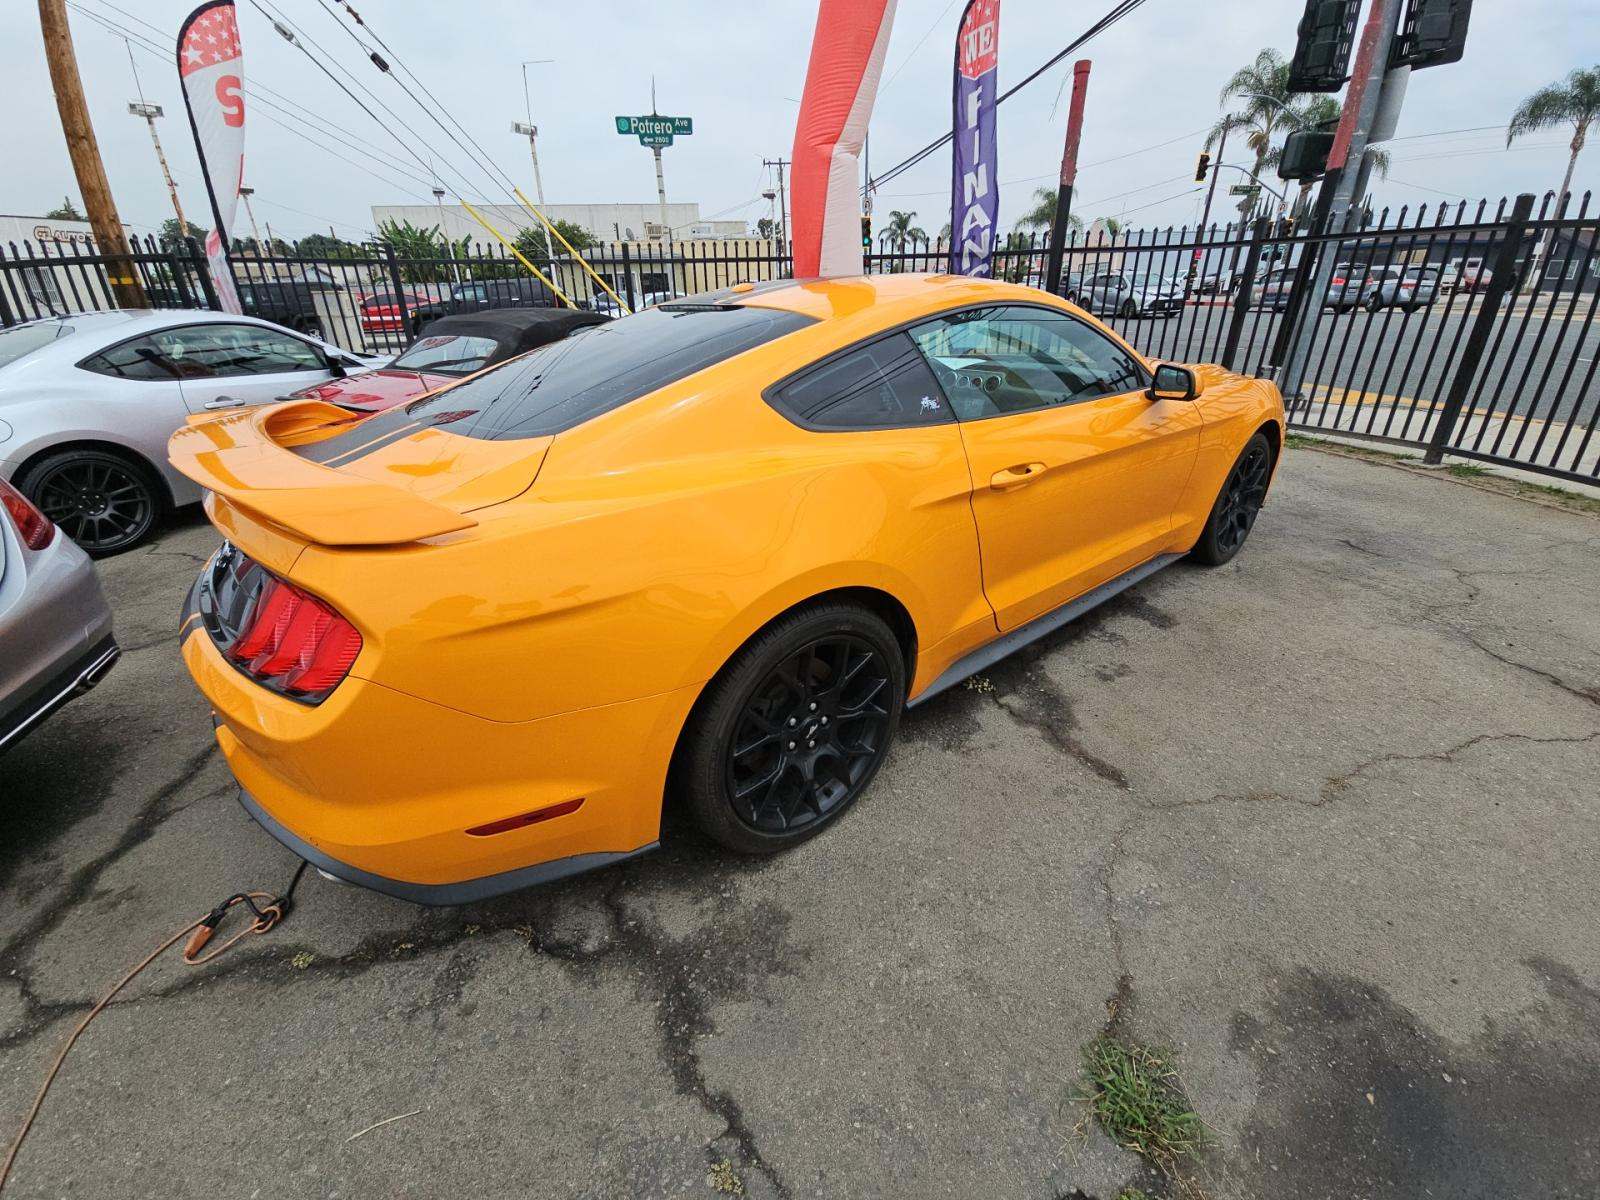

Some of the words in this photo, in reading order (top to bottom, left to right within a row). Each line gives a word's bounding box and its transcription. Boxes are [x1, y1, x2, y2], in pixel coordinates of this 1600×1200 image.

[963, 21, 995, 65] WE
[630, 117, 673, 134] Potrero
[674, 118, 689, 127] Ave
